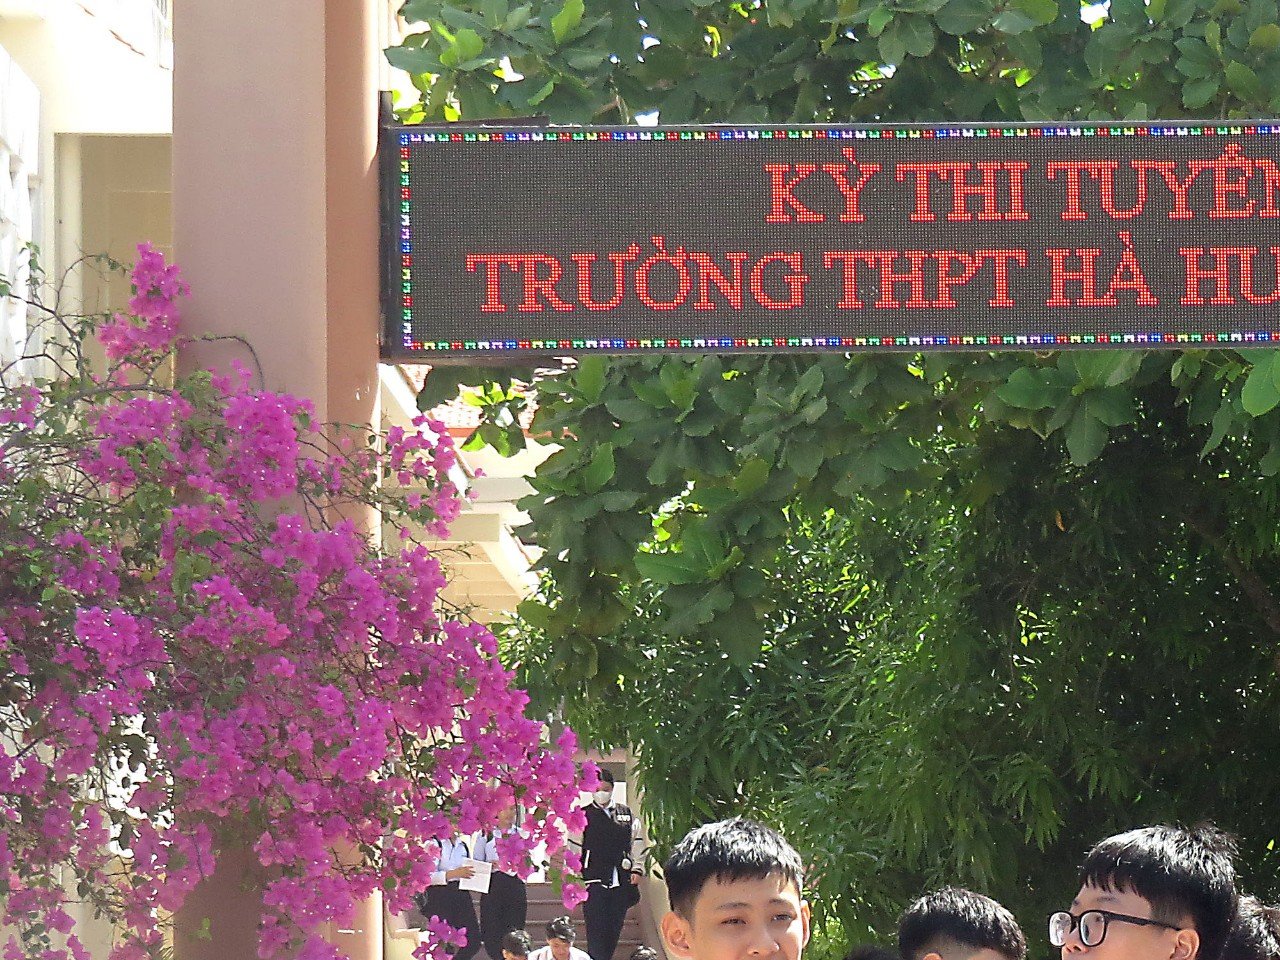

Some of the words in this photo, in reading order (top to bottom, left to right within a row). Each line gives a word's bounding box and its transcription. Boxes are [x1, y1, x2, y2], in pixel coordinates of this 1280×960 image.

[764, 147, 882, 223] KỲ
[895, 160, 1030, 223] THI
[466, 236, 810, 313] TRƯỜNG
[823, 248, 1028, 310] THPT
[1047, 231, 1159, 307] HÀ
